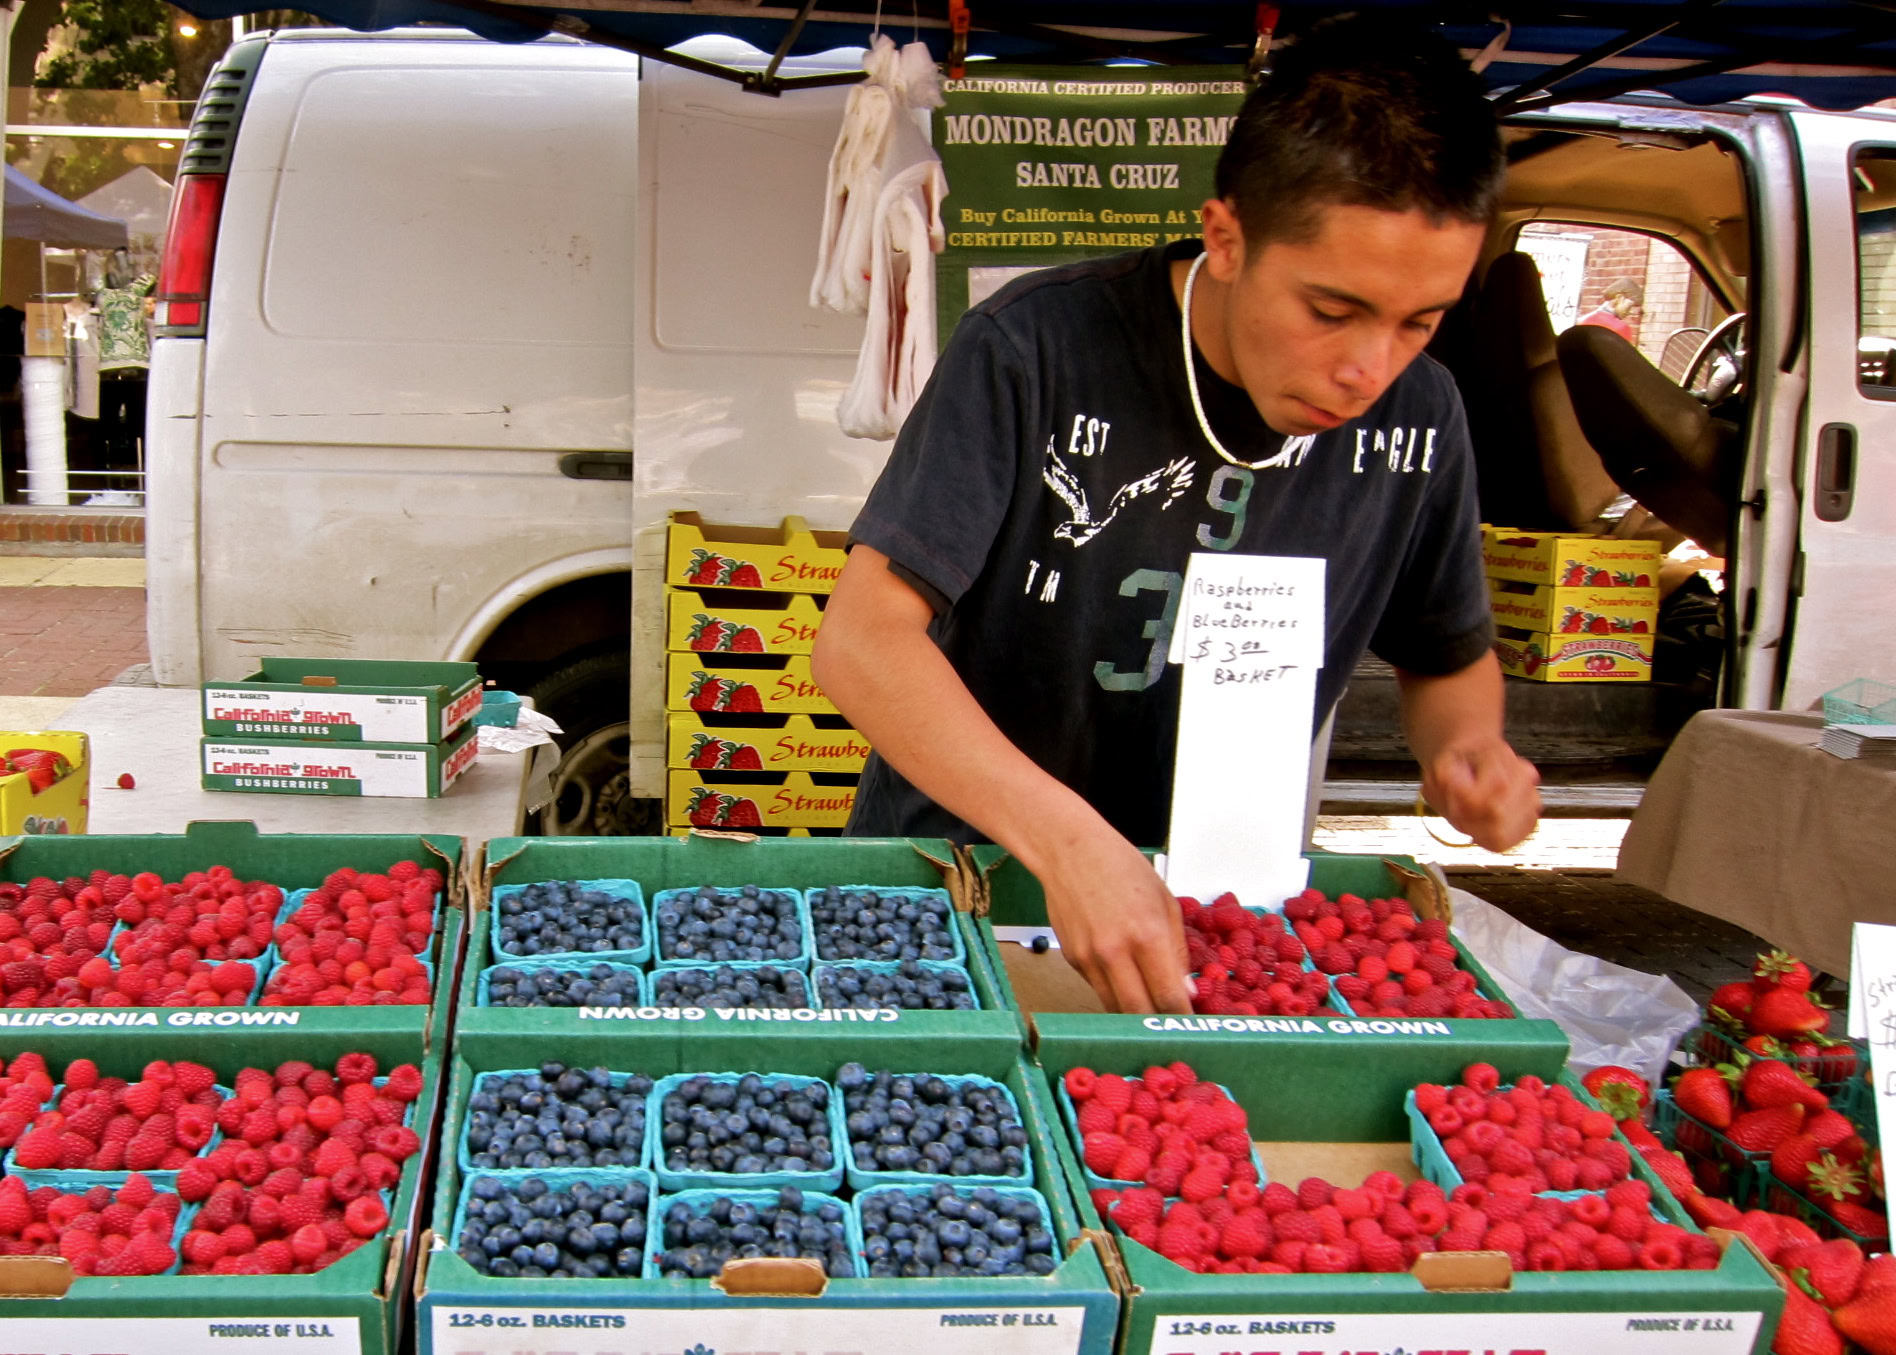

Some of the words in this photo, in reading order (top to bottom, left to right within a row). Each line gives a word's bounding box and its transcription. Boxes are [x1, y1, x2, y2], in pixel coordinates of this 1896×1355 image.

[945, 79, 1049, 95] CALIFORNIA
[1054, 81, 1146, 96] CERTIFIED
[1150, 81, 1246, 96] PRODUCER
[945, 114, 1136, 147] MONDRAGON
[1016, 161, 1102, 189] SANTA
[1109, 163, 1180, 190] CRUZ
[959, 208, 997, 227] Buy
[1001, 207, 1095, 224] California
[1099, 209, 1161, 225] Grown
[1164, 209, 1188, 225] At
[948, 232, 1057, 248] CERTIFIED
[1061, 231, 1160, 248] FARMERS'
[1068, 414, 1111, 457] EST
[1353, 426, 1437, 473] EAGLE
[1196, 464, 1255, 551] 9
[1193, 576, 1296, 598] Raspberries
[235, 723, 330, 735] BUSHBERRIES
[234, 778, 330, 790] BUSHBERRIES
[0, 1012, 159, 1027] ALIFORNIA
[167, 1011, 300, 1026] GROWN
[578, 1006, 706, 1020] GROWN
[713, 1007, 899, 1022] CALIFORNIA
[1142, 1017, 1325, 1034] CALIFORNIA
[1327, 1019, 1452, 1036] GROWN
[449, 1313, 494, 1328] 12-6
[496, 1315, 527, 1328] oz.
[532, 1314, 626, 1329] BASKETS
[940, 1314, 998, 1327] PRODUCE
[1002, 1314, 1019, 1326] OF
[1170, 1322, 1212, 1336] 12-6
[1215, 1323, 1243, 1335] oz.
[1249, 1321, 1336, 1336] BASKETS
[1625, 1318, 1681, 1332] PRODUCE
[1683, 1318, 1700, 1331] OF
[209, 1323, 271, 1338] PRODUCE
[274, 1323, 291, 1338] OF
[296, 1323, 334, 1338] U.S.A.
